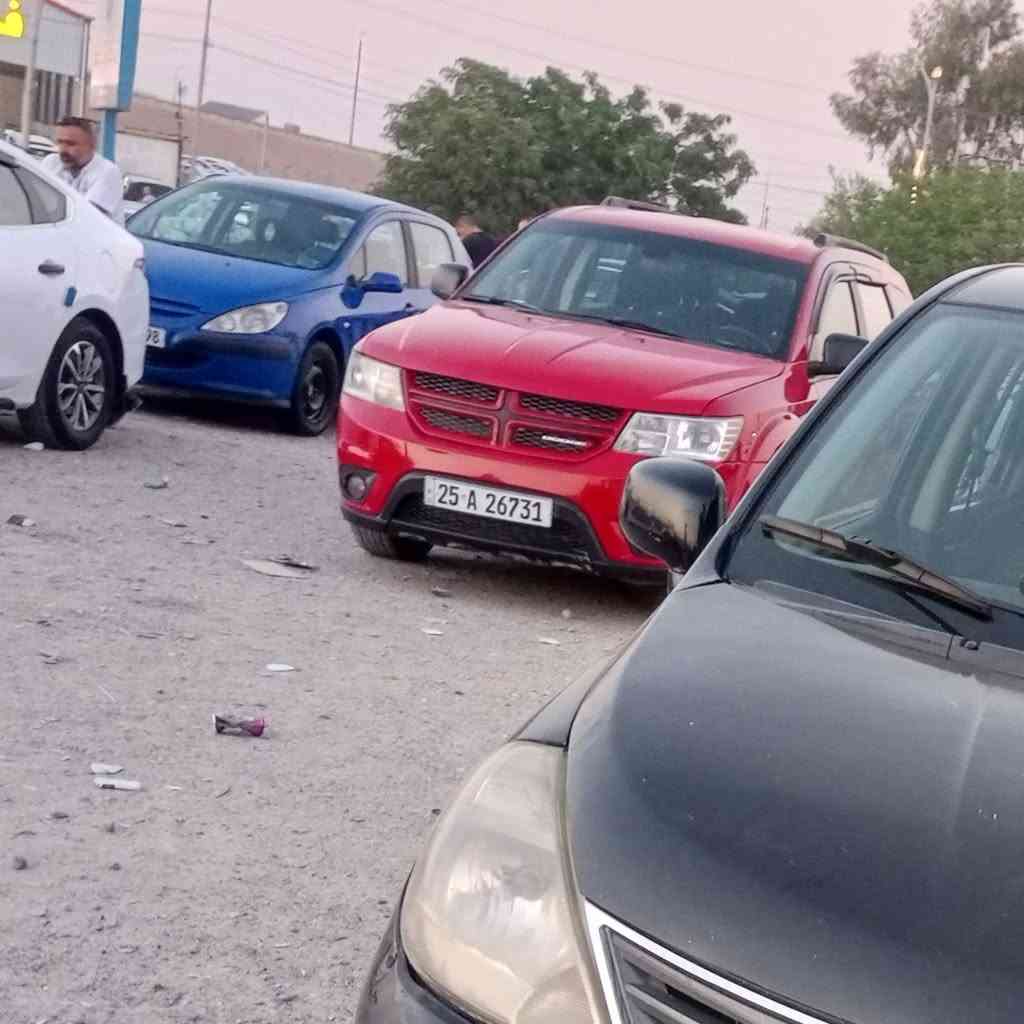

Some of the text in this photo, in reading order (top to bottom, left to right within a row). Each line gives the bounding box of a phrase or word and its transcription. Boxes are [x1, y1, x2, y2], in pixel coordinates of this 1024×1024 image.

[438, 484, 543, 522] 25 A 26731
